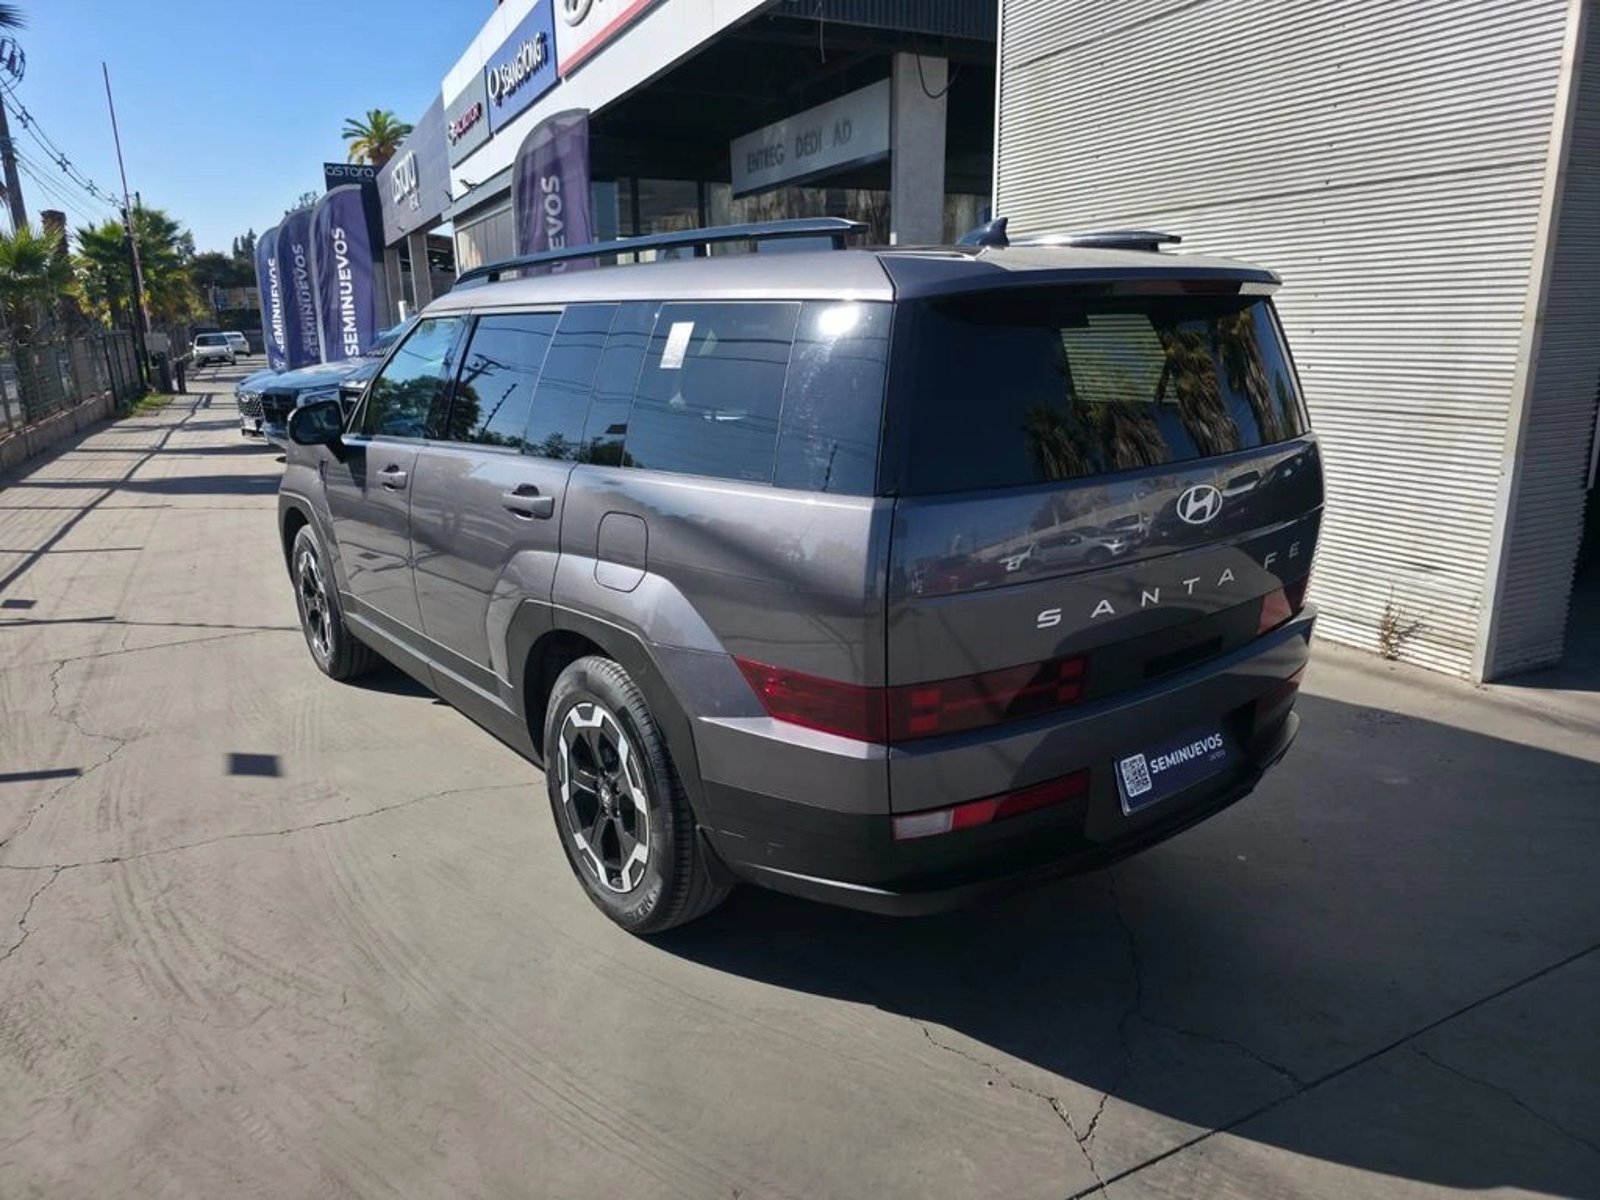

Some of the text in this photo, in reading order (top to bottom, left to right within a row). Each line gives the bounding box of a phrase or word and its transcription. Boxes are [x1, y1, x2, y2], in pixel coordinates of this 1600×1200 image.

[332, 227, 359, 356] SEMINUEVOS
[1036, 543, 1300, 629] SANTA FE
[1150, 733, 1223, 774] SEMINUEVOS
